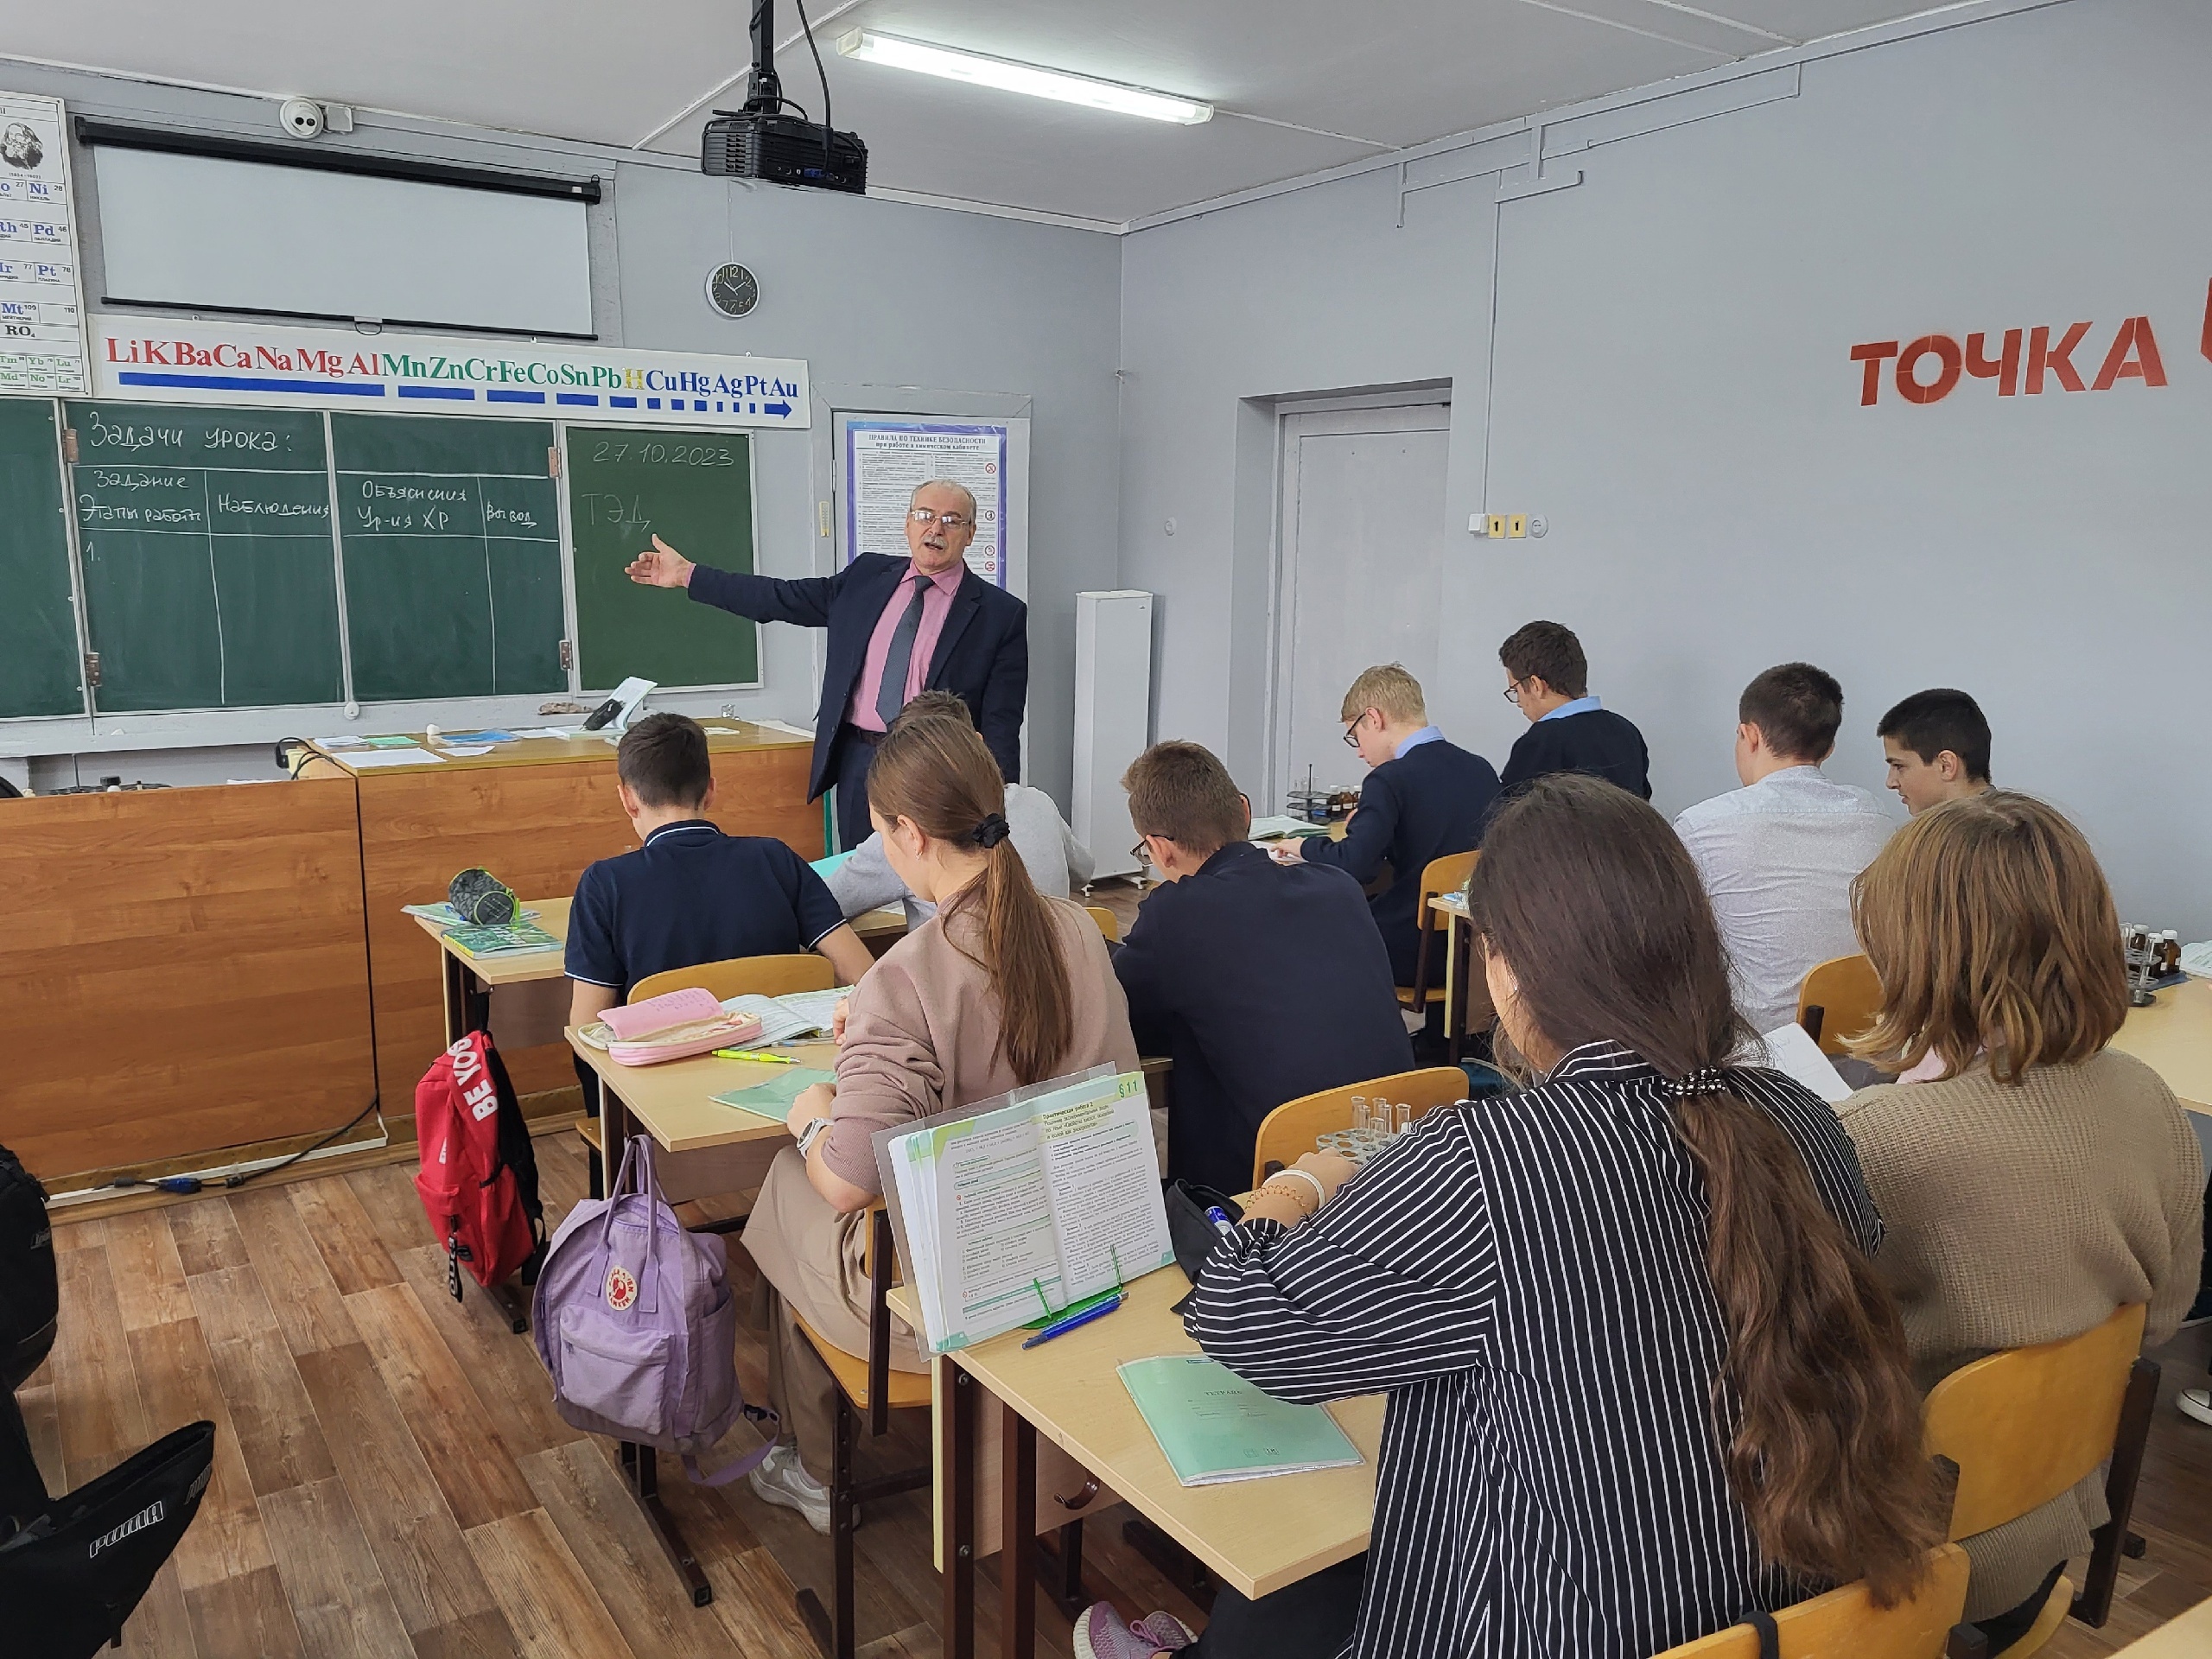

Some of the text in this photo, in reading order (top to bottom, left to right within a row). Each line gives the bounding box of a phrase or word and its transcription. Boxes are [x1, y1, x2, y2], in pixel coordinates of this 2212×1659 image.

[29, 182, 48, 195] Ni
[34, 224, 55, 236] Pd
[37, 264, 56, 276] Pt
[730, 266, 739, 277] 12
[1, 303, 24, 315] Mt
[1849, 315, 2169, 407] ТОЧКА
[58, 375, 71, 384] Lr
[89, 411, 292, 452] Задачи урока:
[593, 441, 734, 467] 27.10.2023
[93, 470, 189, 492] Задание
[79, 493, 139, 522] Этапы
[581, 493, 652, 533] ТЭД
[462, 1078, 499, 1122] BE
[89, 1500, 164, 1559] PUMA
